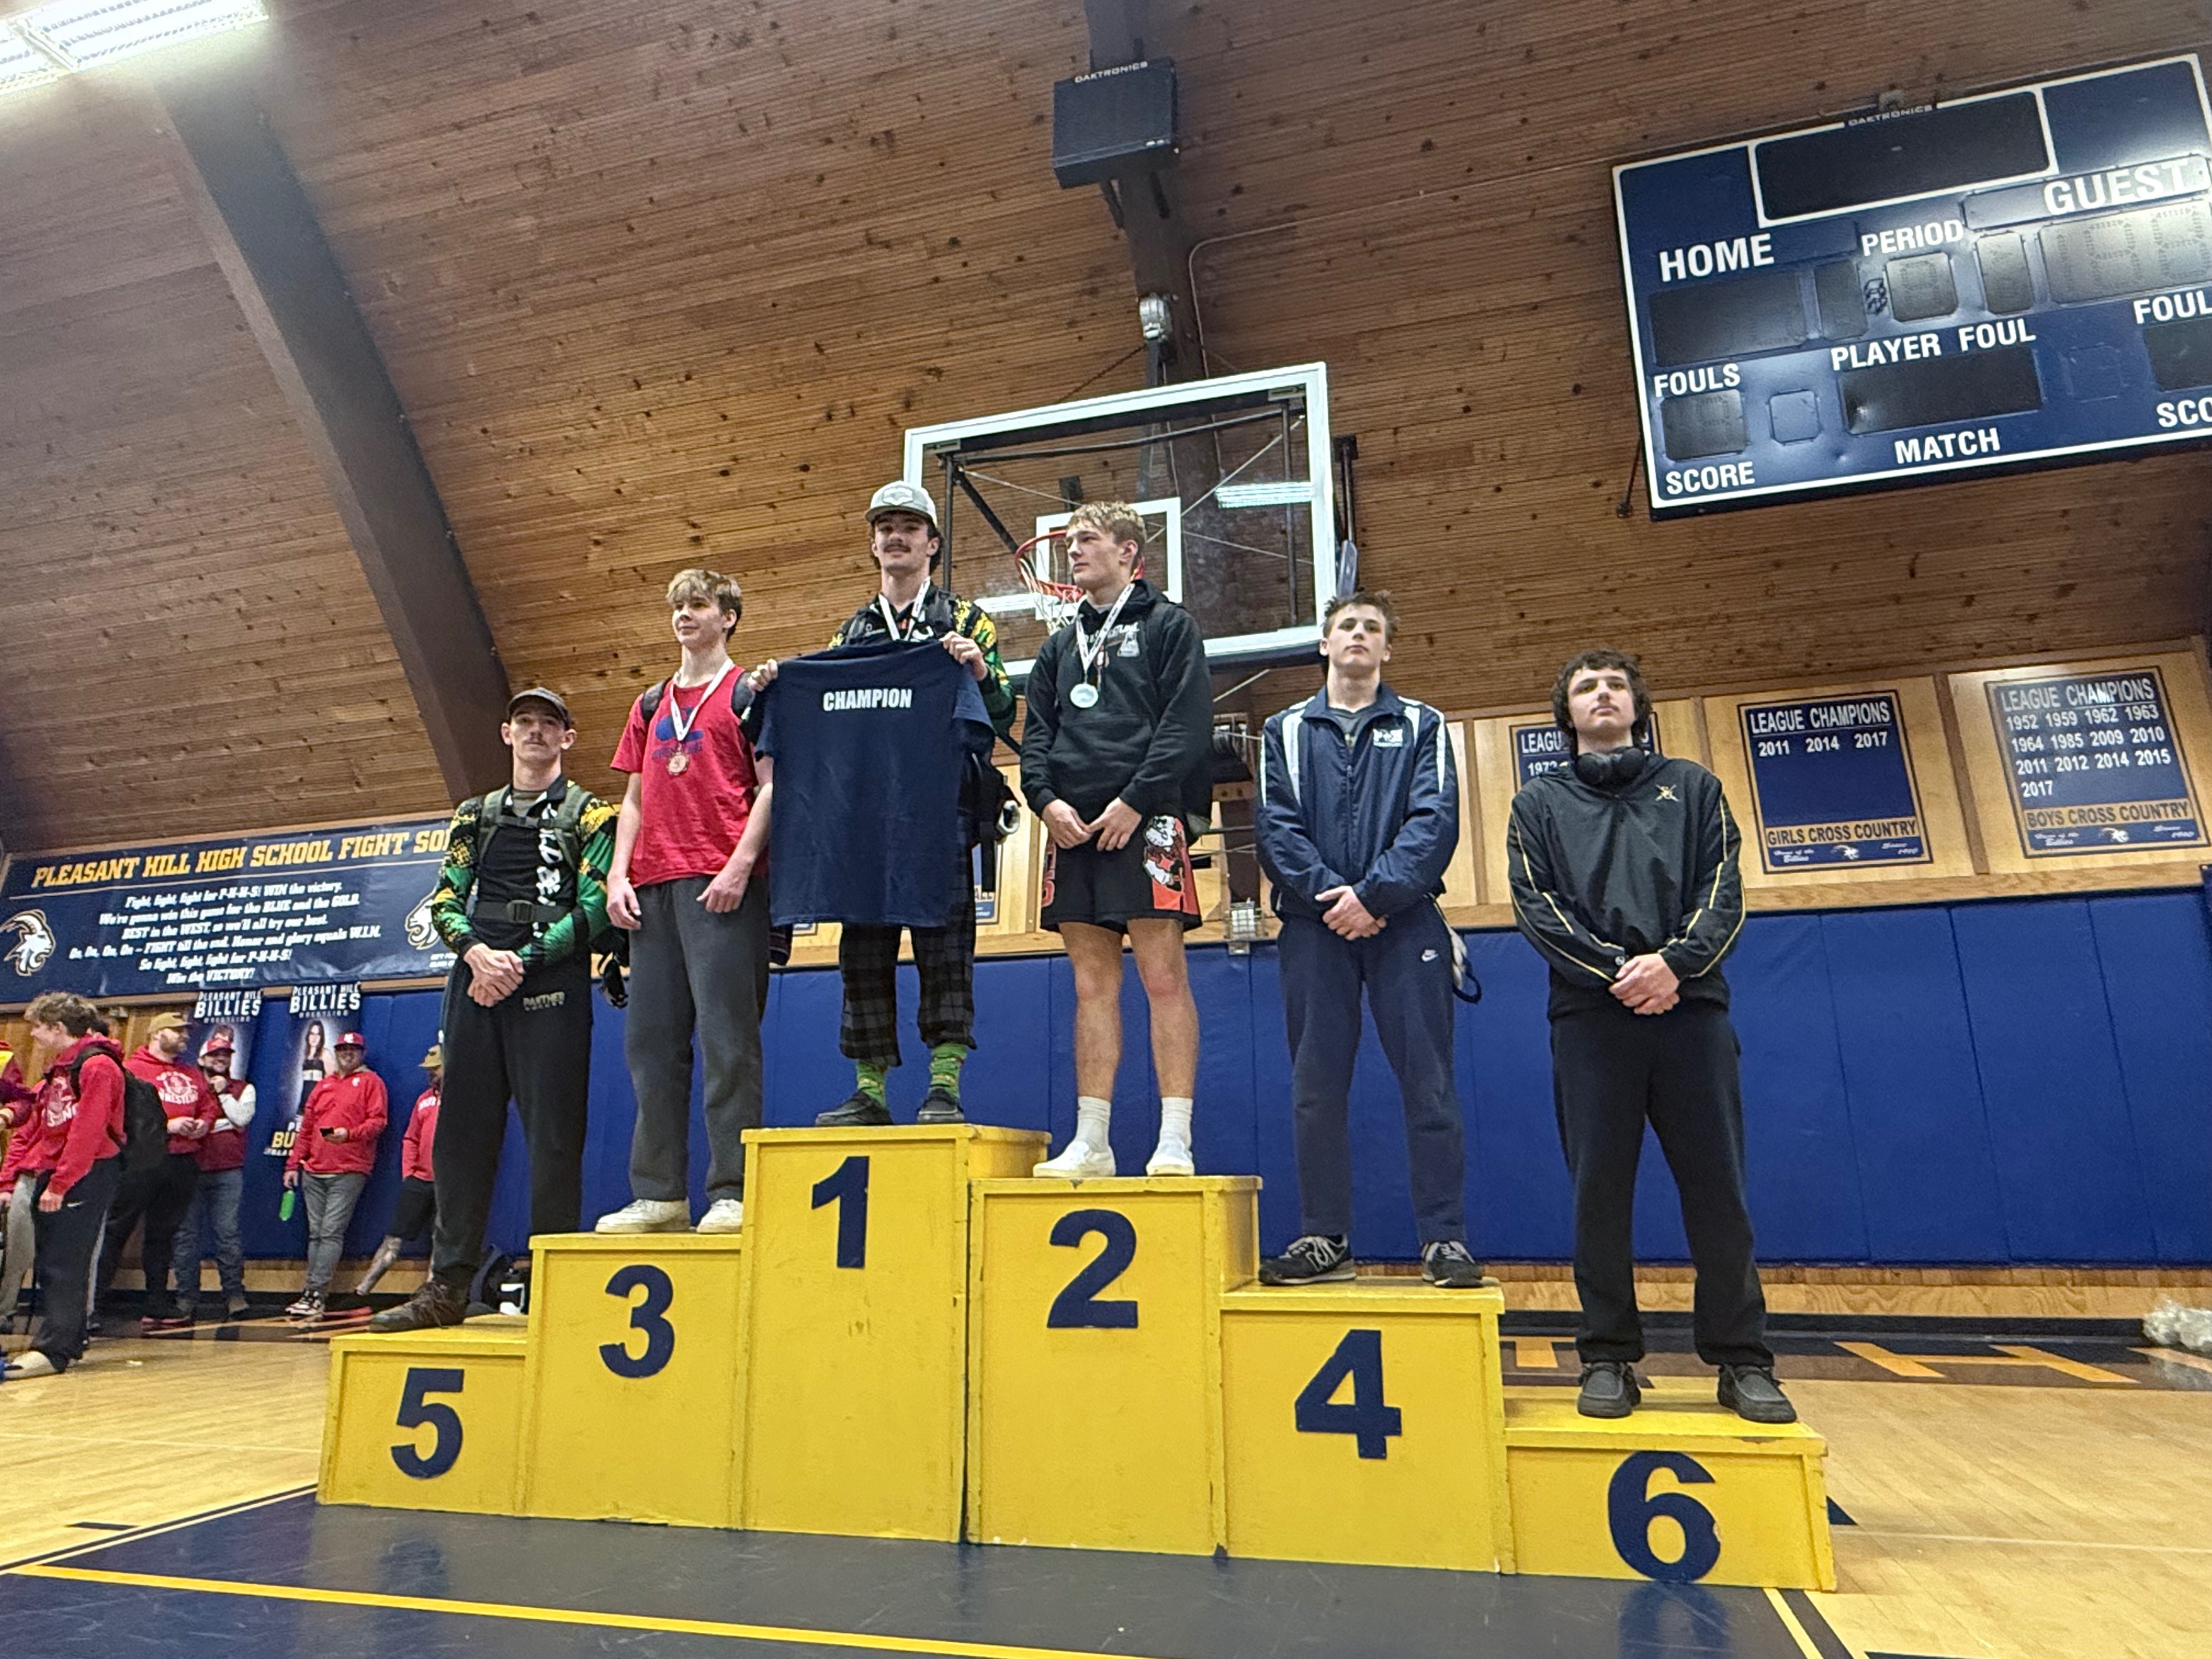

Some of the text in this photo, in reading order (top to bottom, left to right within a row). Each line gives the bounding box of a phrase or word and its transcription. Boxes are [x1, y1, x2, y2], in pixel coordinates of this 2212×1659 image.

[1074, 61, 1148, 83] DAKTRONICS
[2044, 159, 2189, 215] GUEST
[1861, 219, 1963, 256] PERIOD
[1660, 233, 1775, 282] HOME
[1830, 318, 2036, 371] PLAYER FOUL
[1654, 363, 1740, 397] FOULS
[1894, 427, 2000, 464] MATCH
[1666, 461, 1755, 494] SCORE
[823, 688, 913, 712] CHAMPION
[2001, 678, 2155, 712] LEAGUE CHAMPIONS
[1750, 701, 1891, 733] LEAGUE CHAMPIONS
[2006, 704, 2159, 731] 1952 1959 1962 1963
[1521, 731, 1568, 754] LEAGU
[1758, 731, 1888, 757] 2011 2014 2017
[2012, 725, 2165, 753] 1964 1985 2009 2010
[2016, 748, 2171, 776] 2011 2012 2014 2015
[2021, 780, 2053, 798] 2017
[2025, 802, 2188, 828] BOYS CROSS COUNTRY
[1768, 820, 1916, 845] GIRLS CROSS COUNTRY
[31, 857, 139, 888] PLEASANT
[142, 853, 191, 877] HILL
[195, 847, 248, 873] HIGH
[250, 839, 333, 867] SCHOOL
[337, 832, 410, 860] FIGHT
[264, 883, 288, 896] WIN
[289, 882, 305, 895] the
[160, 909, 178, 921] win
[180, 907, 199, 919] this
[226, 904, 242, 915] for
[244, 902, 261, 914] the
[262, 899, 292, 913] BLUE
[292, 898, 312, 911] and
[313, 897, 330, 909] the
[121, 927, 150, 940] BEST
[149, 926, 160, 938] in
[161, 924, 178, 936] the
[252, 917, 267, 930] all
[268, 918, 284, 930] try
[284, 918, 303, 927] our
[143, 940, 177, 954] FIGHT
[193, 938, 208, 950] the
[264, 933, 285, 945] and
[285, 932, 313, 946] glory
[313, 928, 348, 944] equals
[230, 952, 246, 964] for
[188, 971, 204, 983] the
[194, 1000, 261, 1018] BILLIES
[289, 993, 360, 1013] BILLIES
[811, 1155, 870, 1269] 1
[1046, 1208, 1138, 1330] 2
[599, 1264, 675, 1379] 3
[1295, 1328, 1403, 1460] 4
[390, 1367, 464, 1480] 5
[1607, 1449, 1722, 1583] 6
